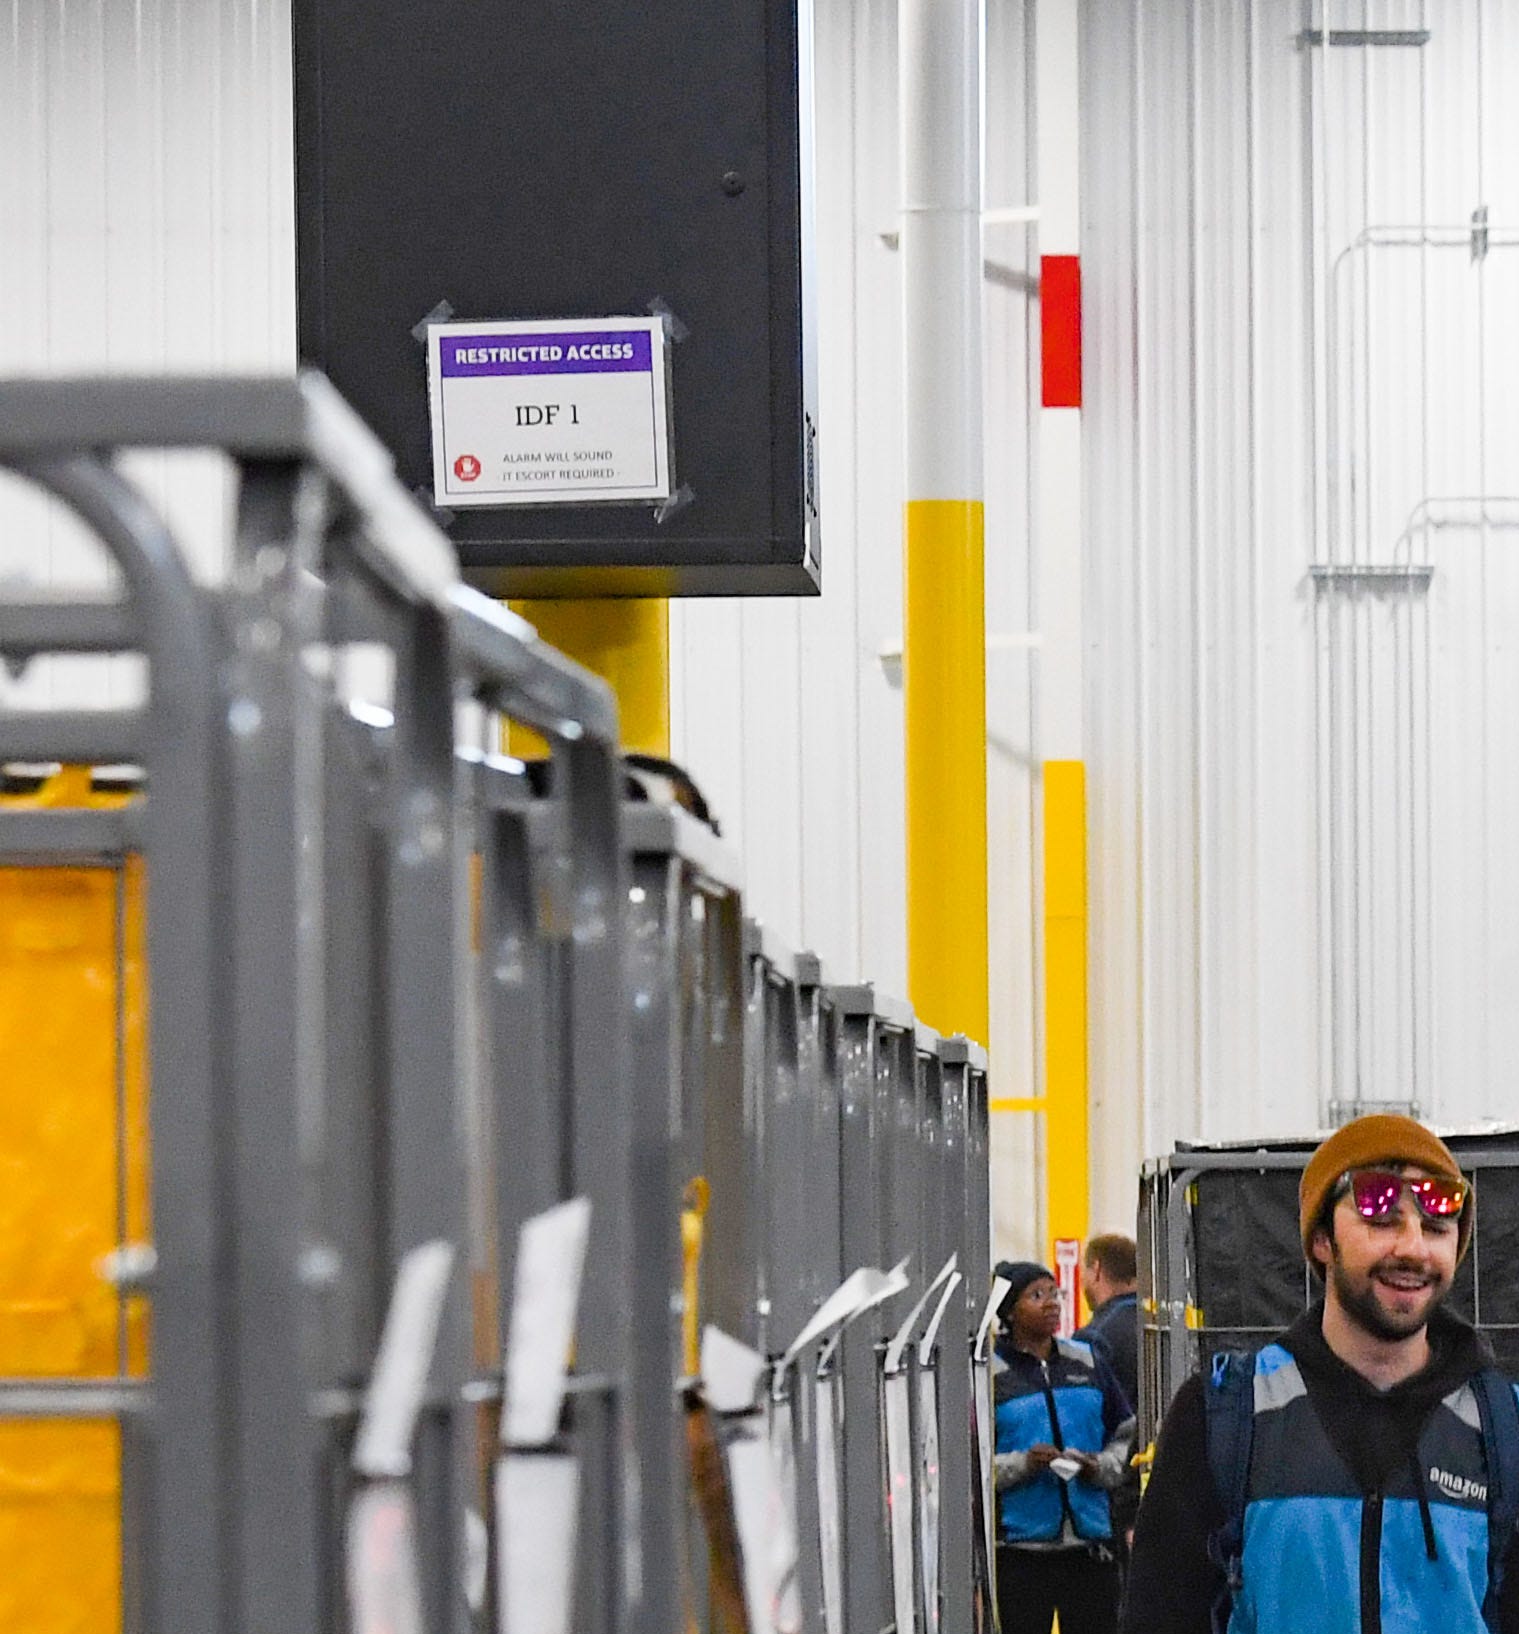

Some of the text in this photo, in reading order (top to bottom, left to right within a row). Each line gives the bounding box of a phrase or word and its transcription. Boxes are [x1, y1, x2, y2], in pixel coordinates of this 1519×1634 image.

[455, 342, 634, 365] RESTRICTED ACCESS
[515, 404, 581, 427] IDF 1
[503, 450, 613, 463] ALARM WILL SOUND
[515, 470, 556, 481] ESCORT
[559, 469, 615, 480] REQUIRED
[1429, 1467, 1488, 1501] amazon
